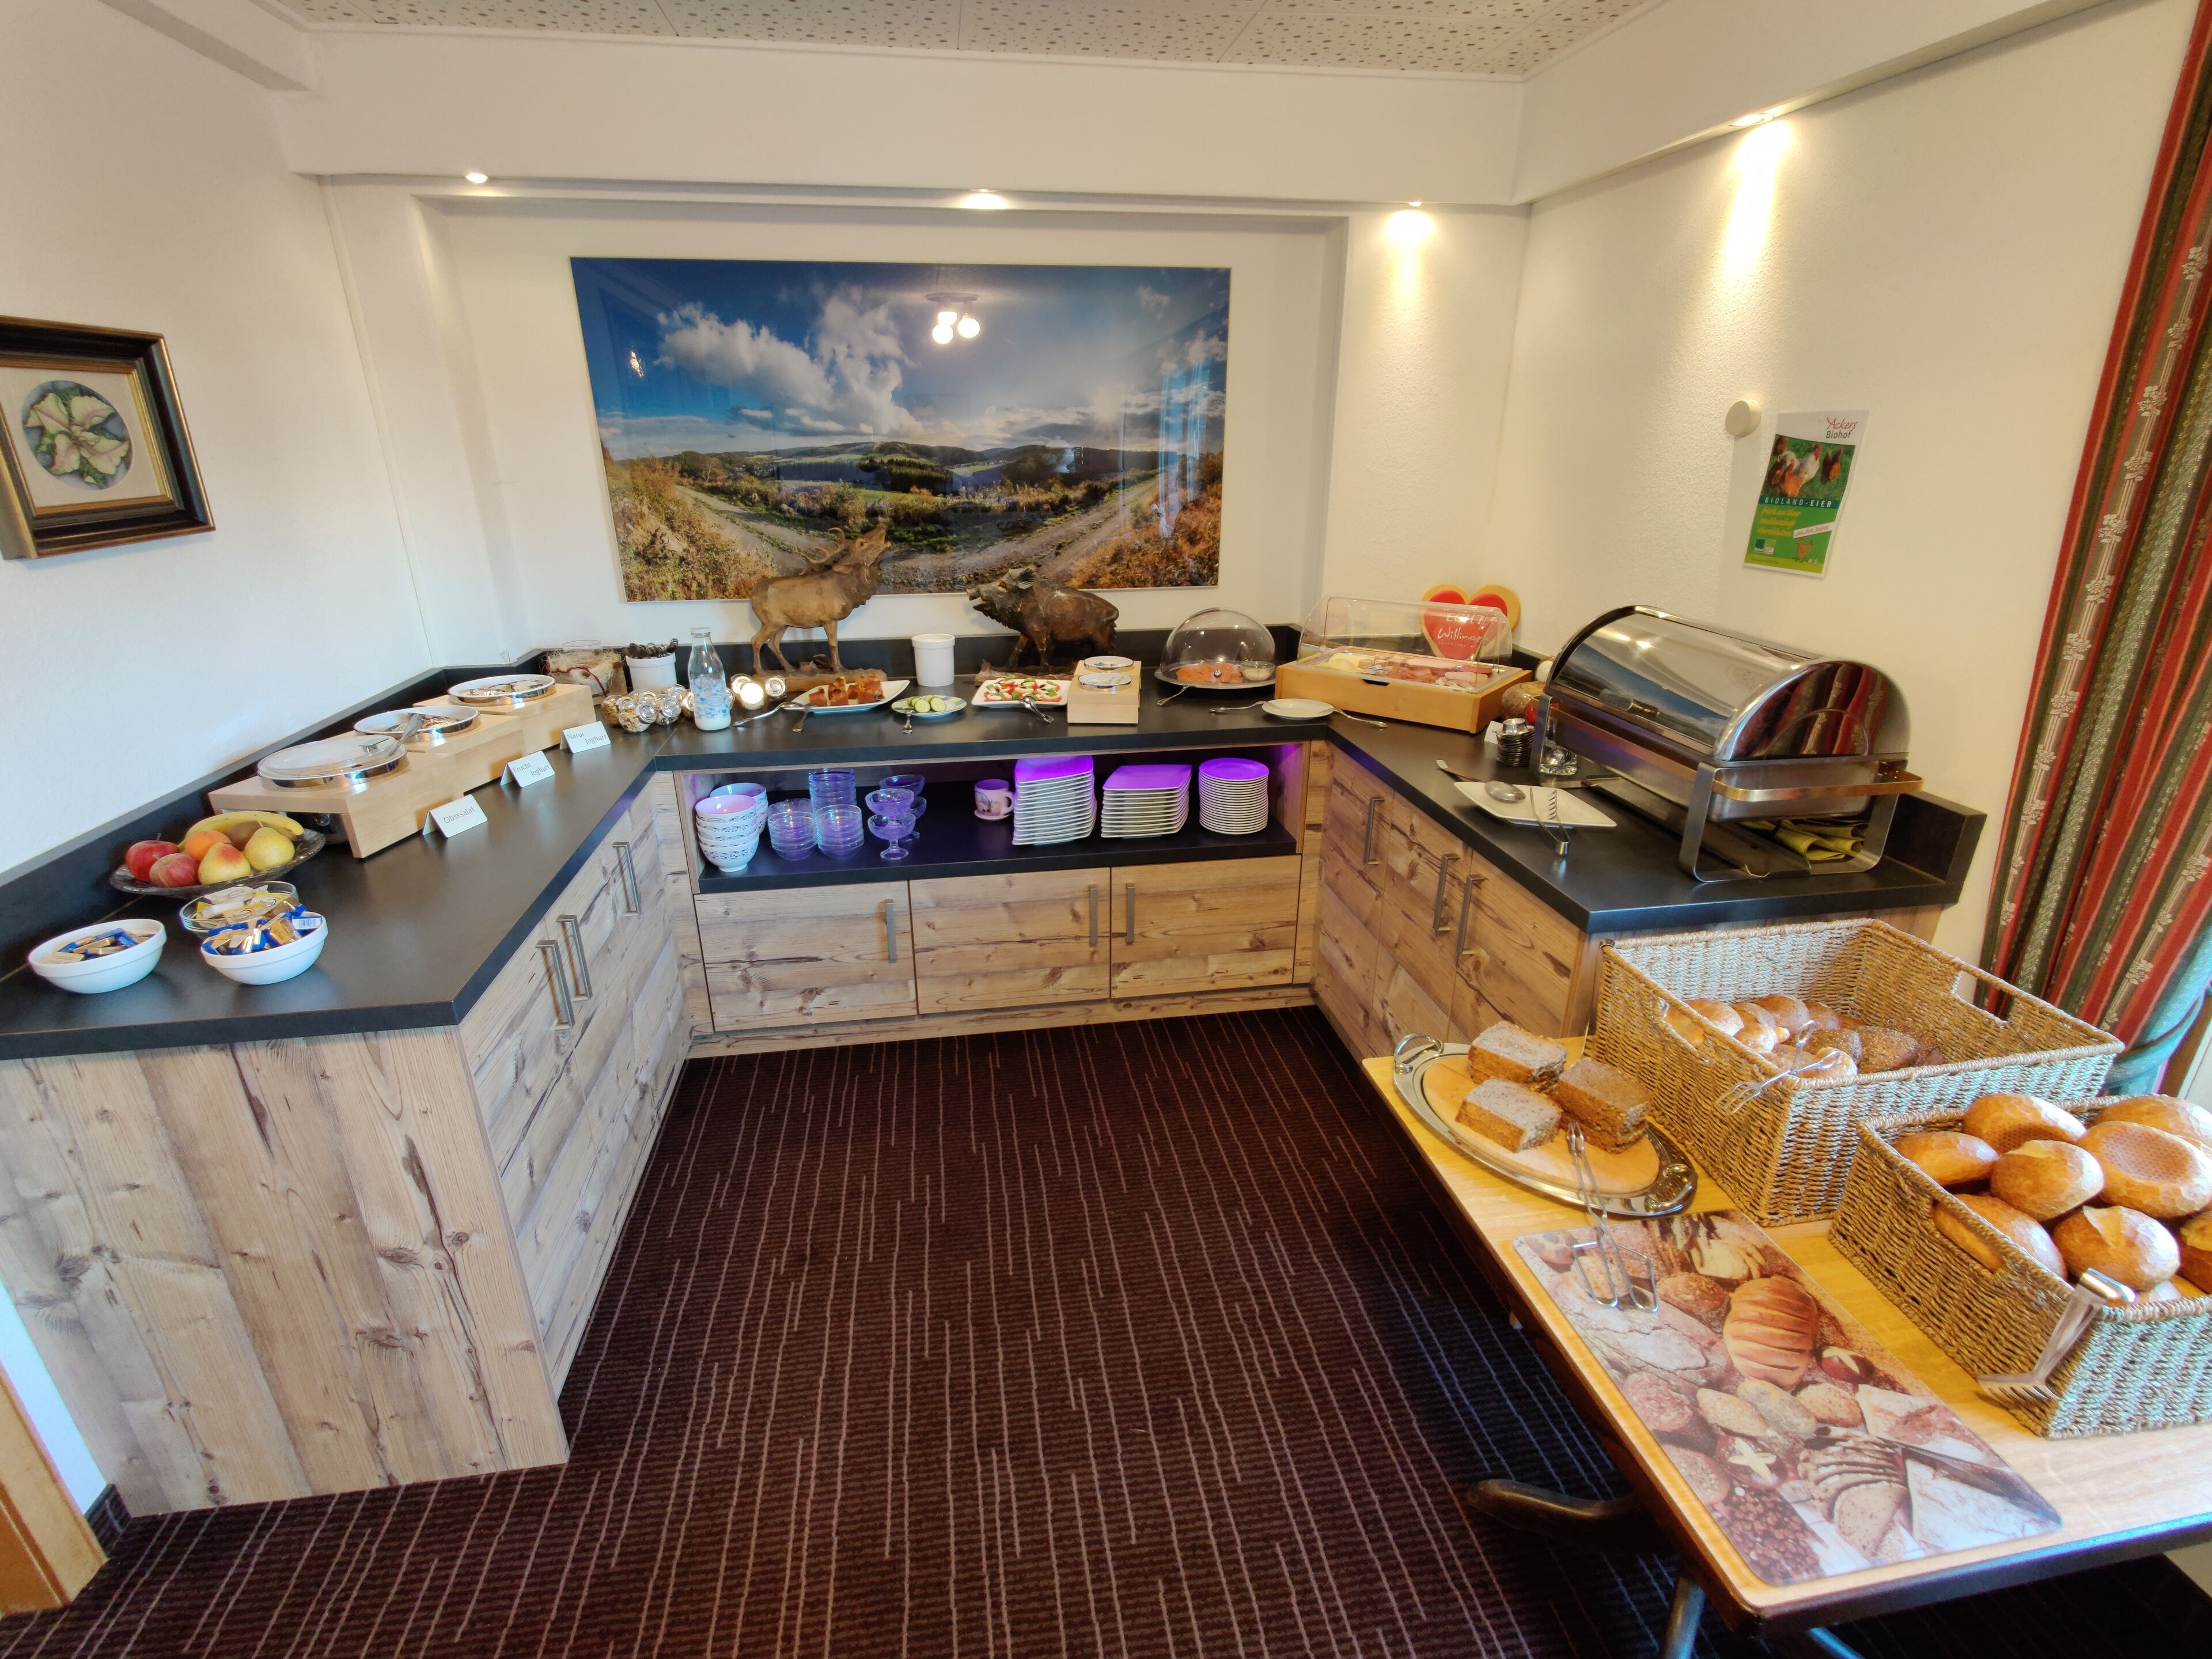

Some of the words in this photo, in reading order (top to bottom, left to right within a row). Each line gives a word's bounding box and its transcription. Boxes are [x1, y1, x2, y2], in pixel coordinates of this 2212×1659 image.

[1825, 429, 1853, 439] Biohof
[585, 734, 607, 745] Joghurt
[512, 762, 532, 774] Frucht
[530, 764, 550, 778] Joghurt
[444, 806, 475, 823] Obstsalat
